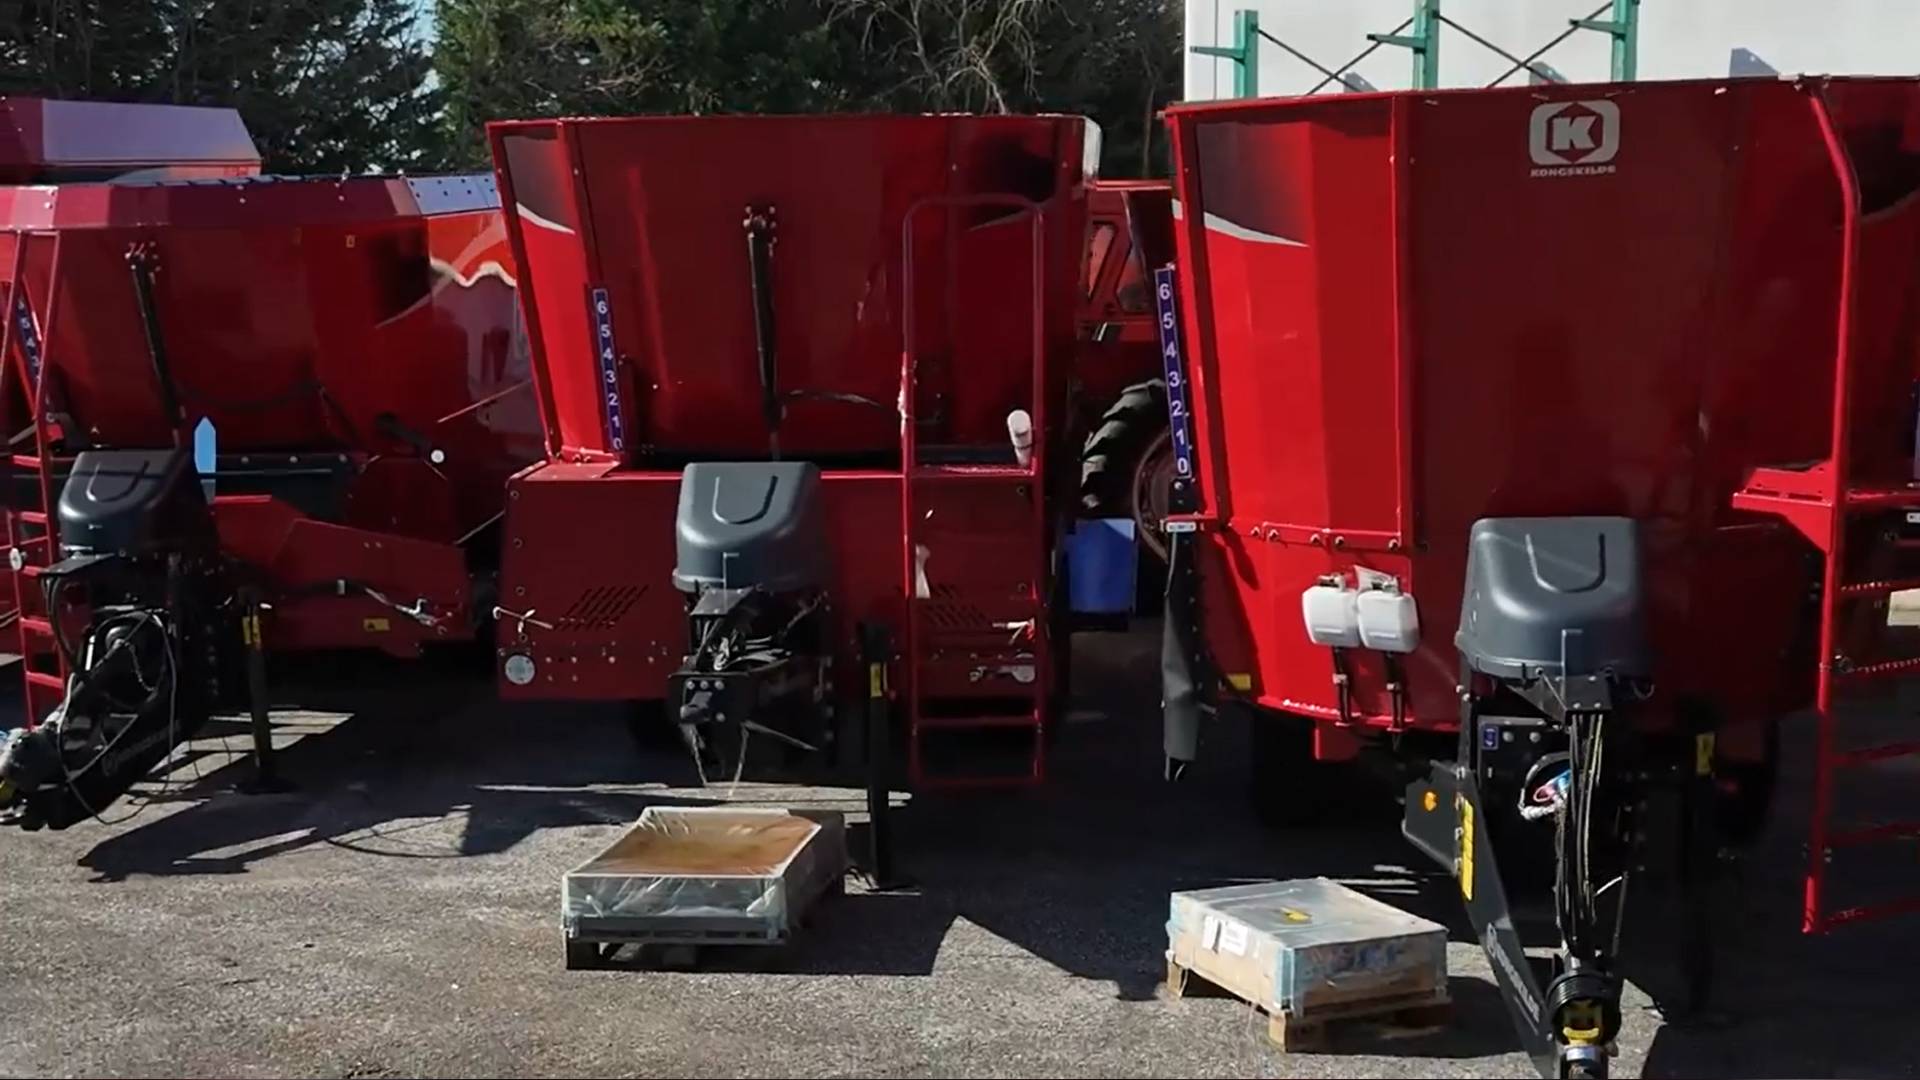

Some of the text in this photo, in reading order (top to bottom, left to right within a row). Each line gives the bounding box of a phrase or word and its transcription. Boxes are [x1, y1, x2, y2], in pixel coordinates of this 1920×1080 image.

[1552, 115, 1597, 151] K
[1530, 165, 1617, 178] KONGSKILDE
[597, 301, 608, 314] 6
[600, 324, 611, 337] 5
[603, 347, 613, 360] 4
[606, 370, 616, 382] 3
[1159, 283, 1188, 473] 6 5 4 3 2 1 0
[608, 393, 618, 406] 2
[611, 416, 620, 428] 1
